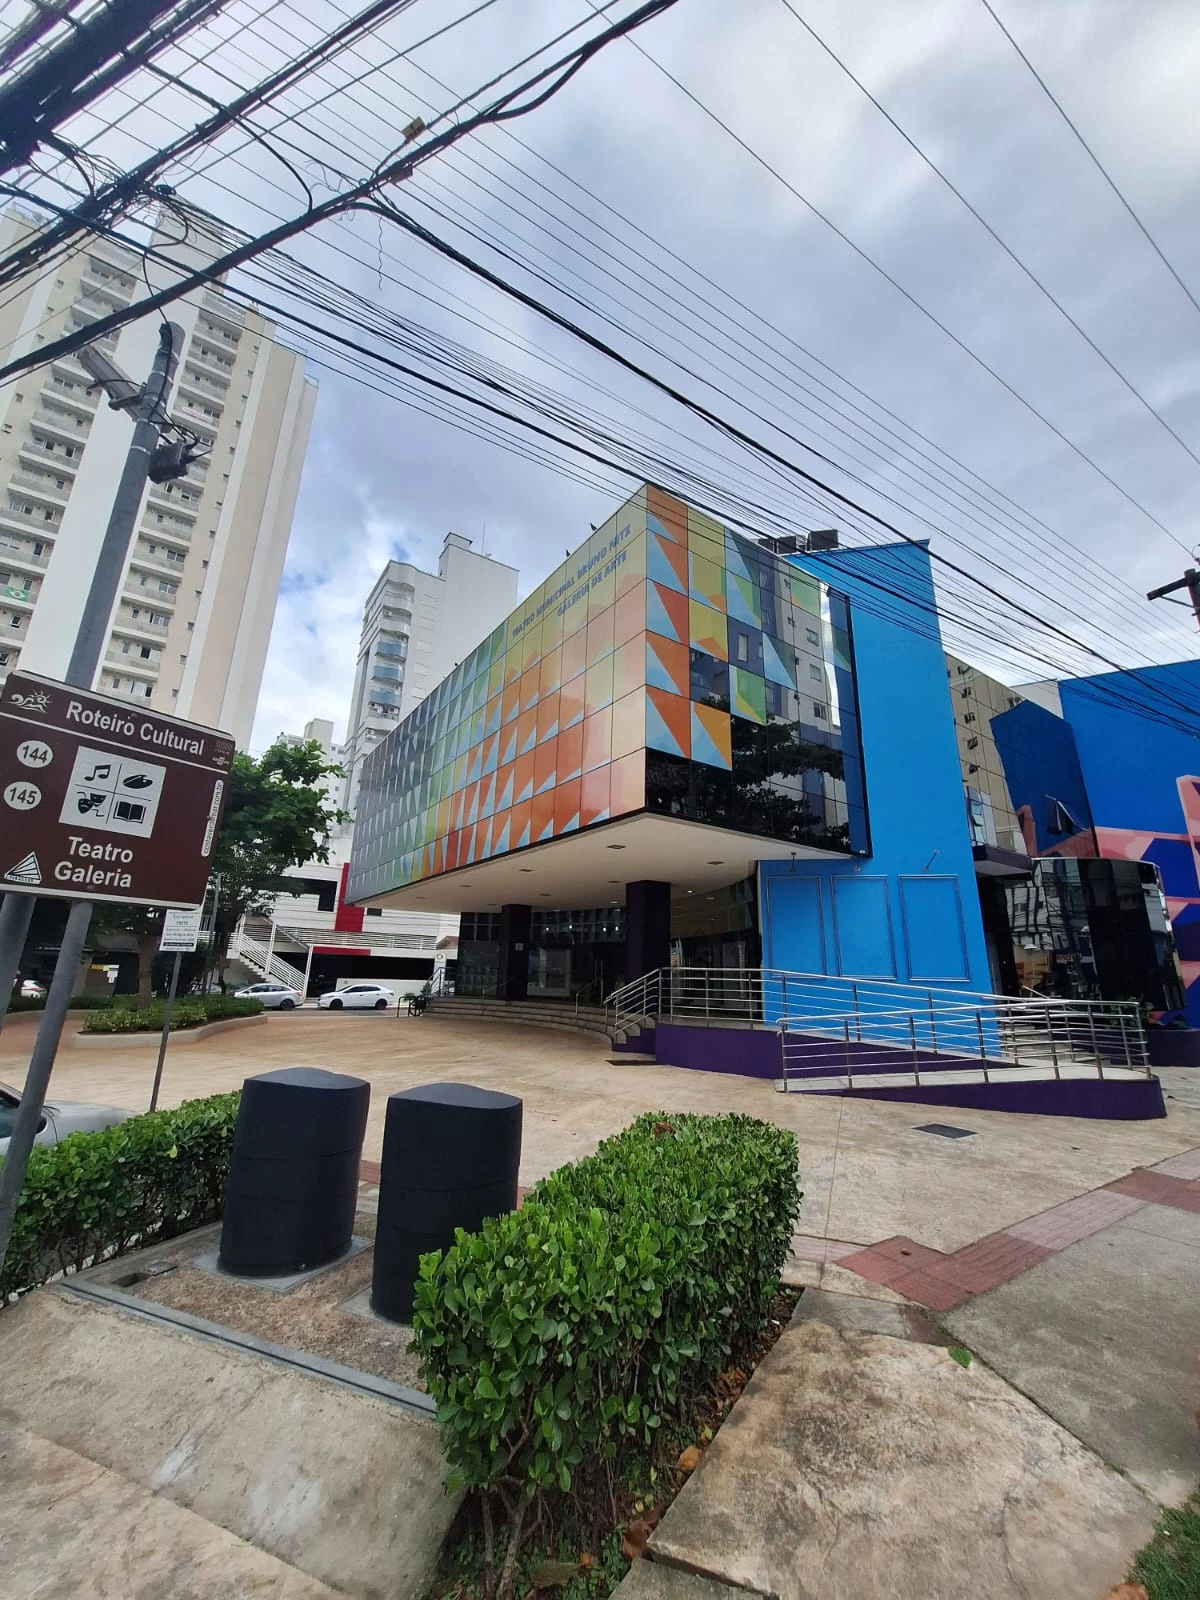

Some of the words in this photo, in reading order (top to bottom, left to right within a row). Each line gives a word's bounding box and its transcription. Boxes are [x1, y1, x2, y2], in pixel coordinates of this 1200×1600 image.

[512, 613, 535, 638] TEATRO
[536, 576, 575, 617] MUNICIPAL
[577, 547, 607, 579] BRUNO
[557, 583, 589, 616] GALERIA
[591, 574, 603, 588] DE
[604, 550, 627, 577] ARTE
[66, 700, 135, 736] Roteiro
[140, 723, 204, 756] Cultural
[22, 745, 48, 763] 144
[10, 787, 37, 805] 145
[203, 781, 223, 853] costavermar.com.br
[68, 836, 133, 863] Teatro
[55, 861, 132, 888] Galeria
